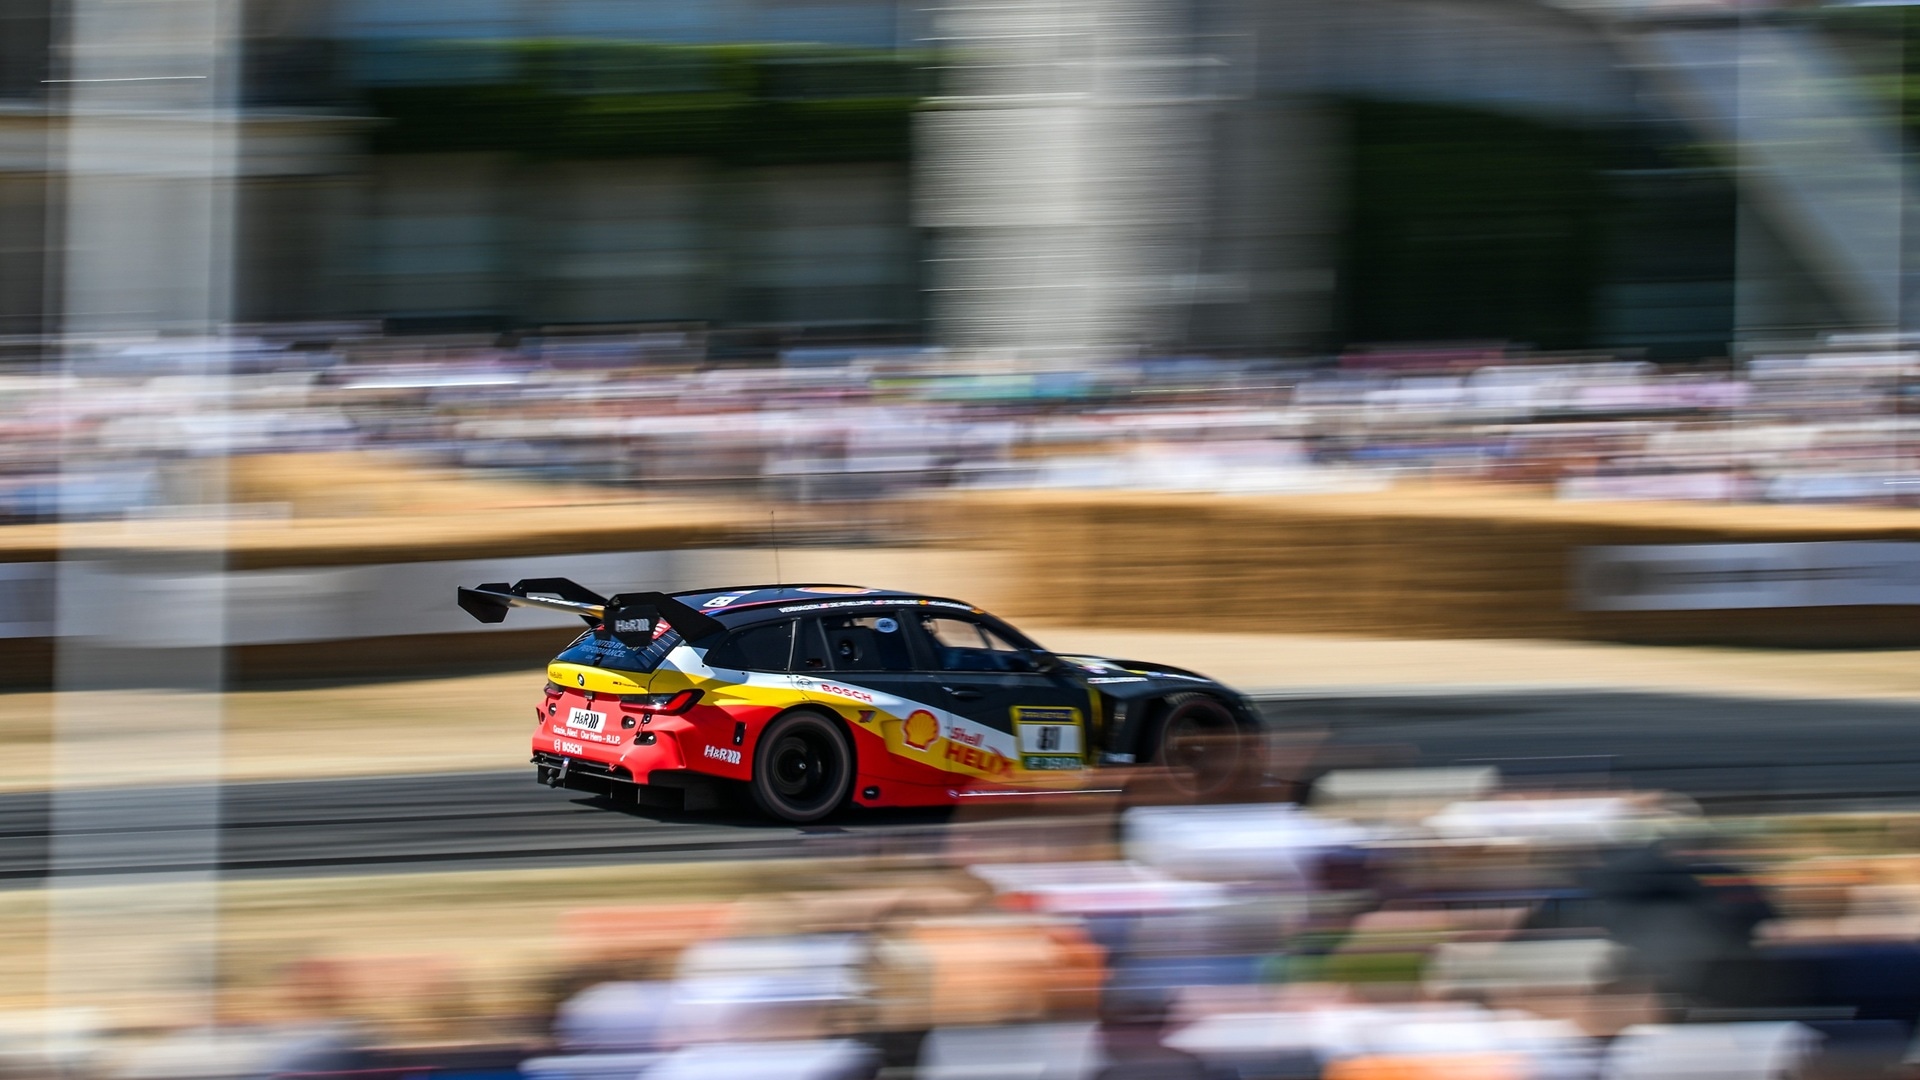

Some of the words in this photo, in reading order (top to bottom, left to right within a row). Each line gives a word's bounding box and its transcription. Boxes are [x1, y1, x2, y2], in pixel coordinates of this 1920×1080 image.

[592, 639, 616, 649] UNITED
[612, 641, 626, 650] BY
[821, 683, 873, 703] BOSCH
[950, 727, 985, 747] Shell
[562, 741, 583, 755] BOSCH
[703, 744, 728, 762] H&R
[944, 741, 1015, 778] HELIX
